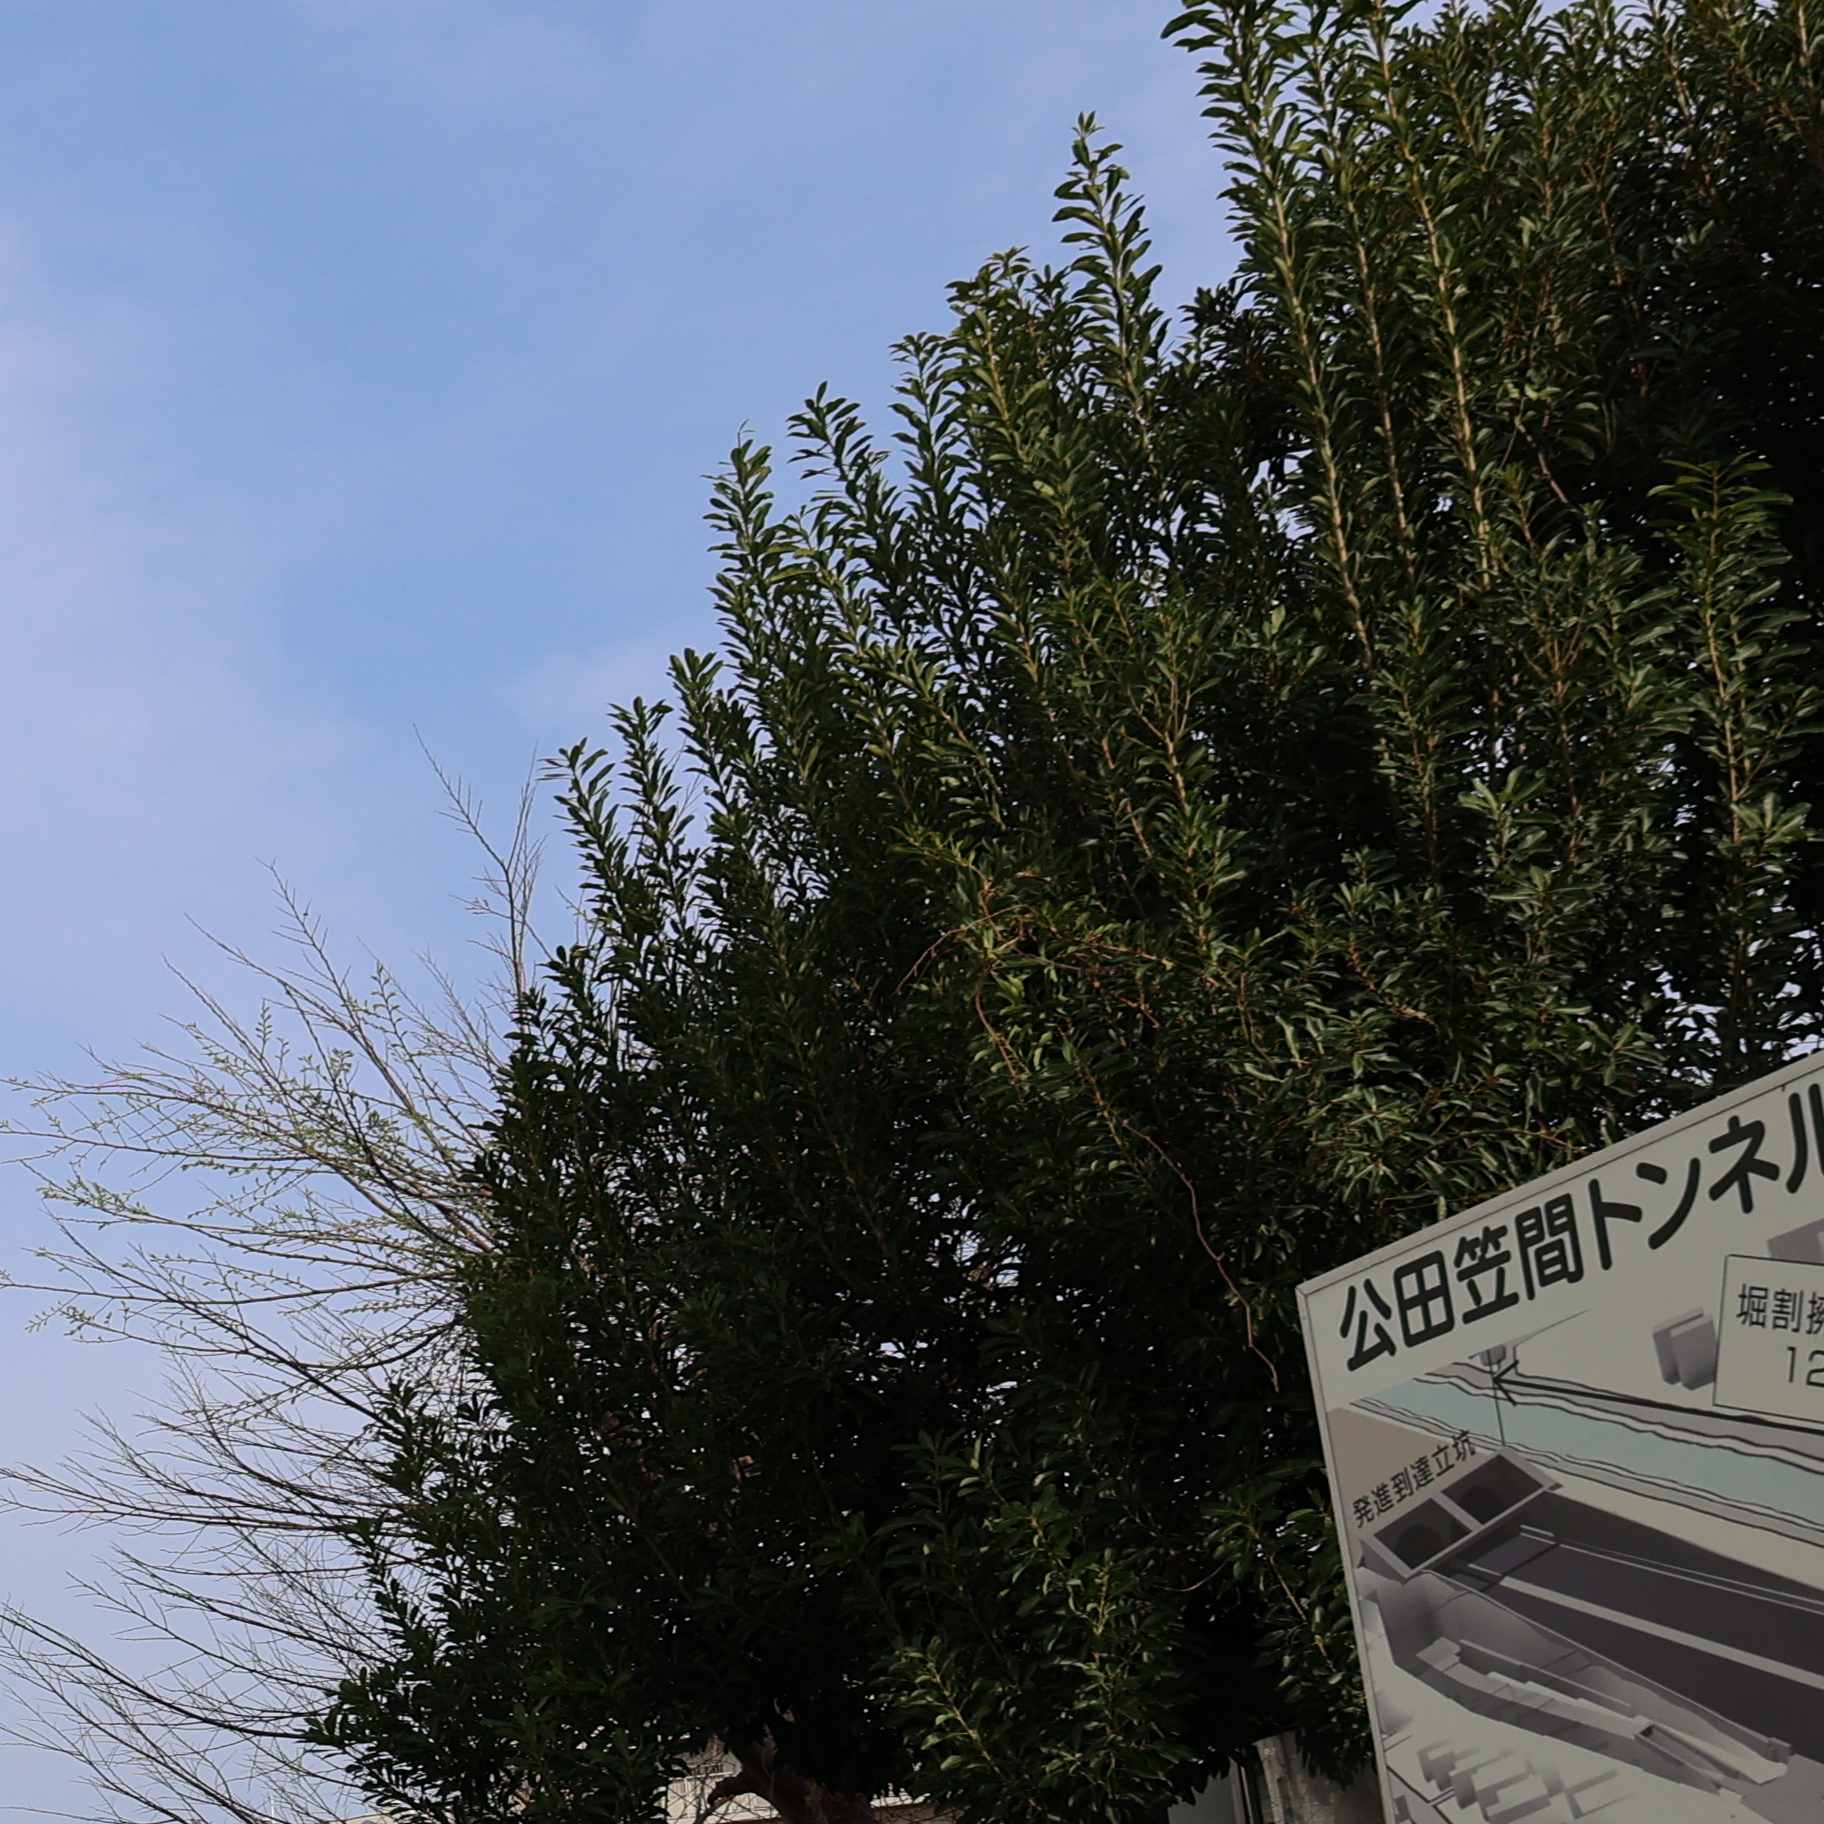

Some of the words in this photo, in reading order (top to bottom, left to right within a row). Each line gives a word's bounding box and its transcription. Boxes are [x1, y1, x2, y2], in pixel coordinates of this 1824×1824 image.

[1340, 1083, 1824, 1372] 公田笠間トンネル
[1352, 1430, 1476, 1529] 発進到達立坑
